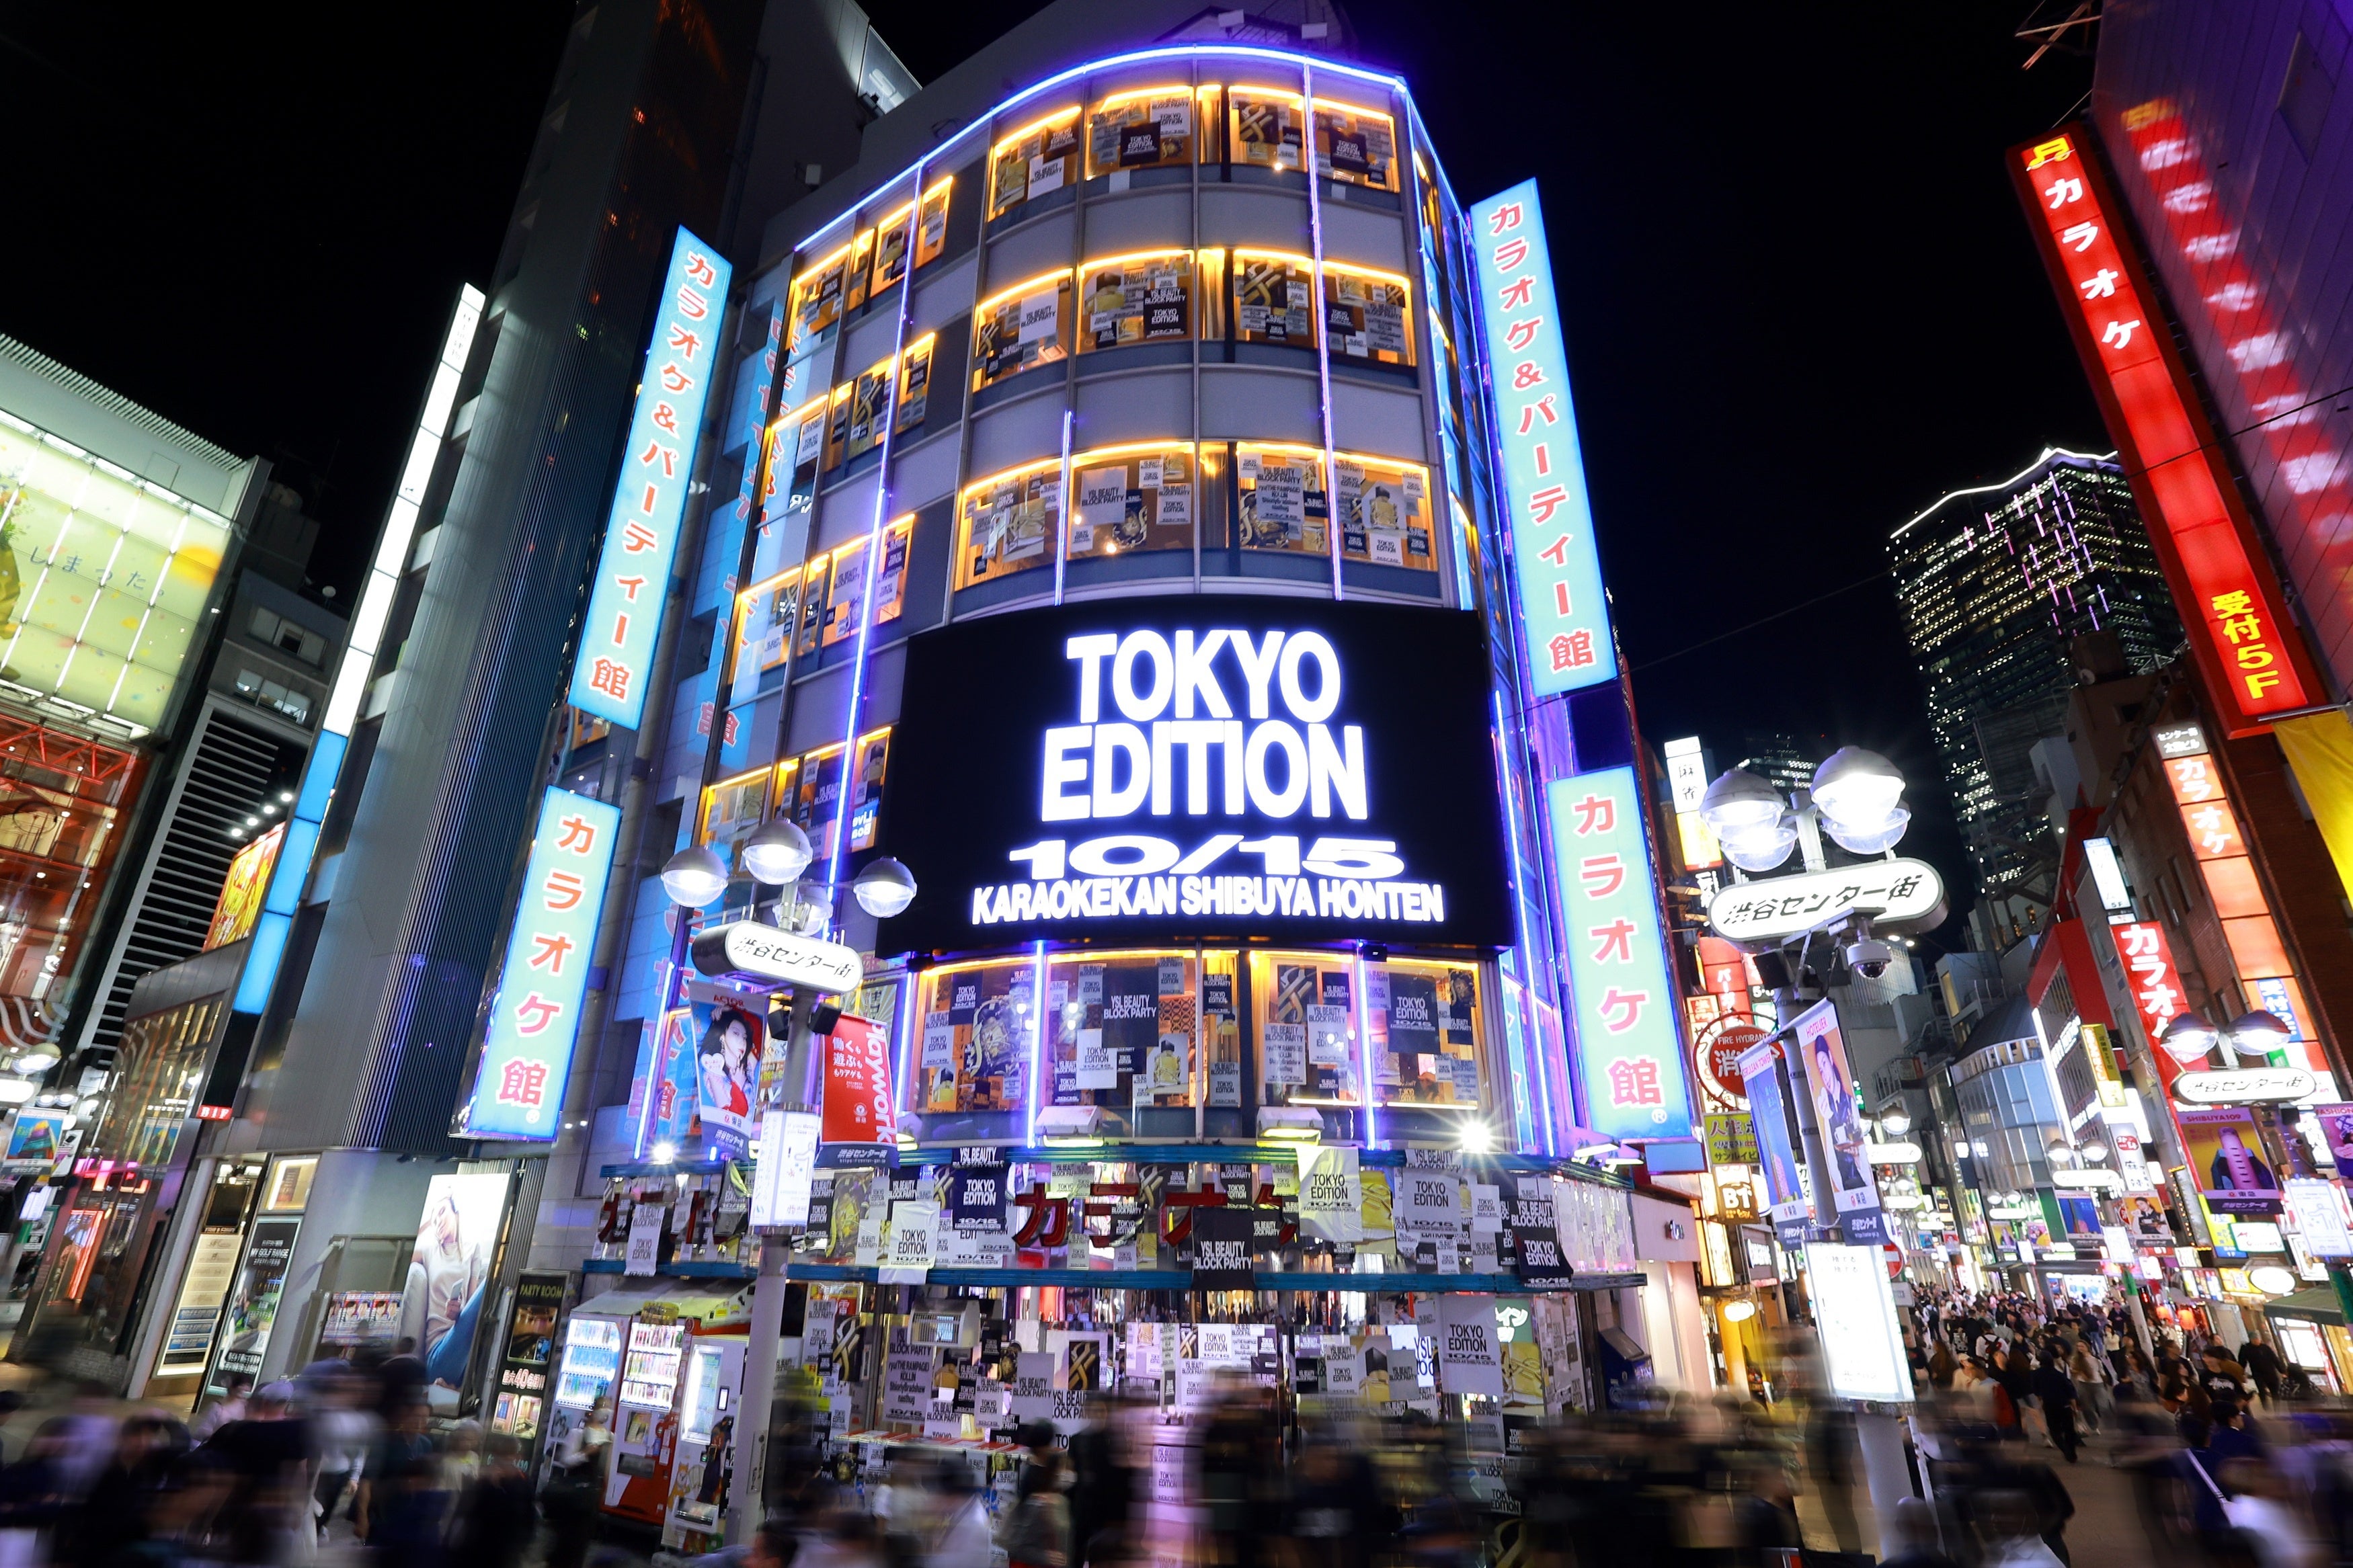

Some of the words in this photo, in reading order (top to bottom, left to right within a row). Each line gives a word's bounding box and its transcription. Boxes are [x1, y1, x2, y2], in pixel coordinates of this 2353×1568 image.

[1130, 135, 1151, 144] TOKYO
[2044, 177, 2141, 349] カラオケ
[1154, 308, 1177, 317] TOKYO
[1152, 315, 1179, 324] EDITION
[1488, 202, 1598, 673] カラオケ&パーティー館
[590, 252, 715, 703] カラオケ&パーティー館
[1275, 468, 1295, 477] BEAUTY
[1257, 474, 1279, 482] BLOCK
[1279, 476, 1301, 485] PARTY
[1088, 489, 1099, 498] YSL
[1099, 487, 1119, 497] BEAUTY
[1082, 497, 1103, 507] BLOCK
[1103, 493, 1124, 504] PARTY
[2211, 589, 2280, 700] 受付5F
[1066, 630, 1341, 723] TOKYO
[1042, 720, 1367, 821] EDITION
[2174, 759, 2231, 854] カラオケ
[1009, 834, 1404, 880] 10/15
[971, 876, 1178, 925] KARAOKEKAN
[1180, 876, 1313, 918] SHIBUYA
[1325, 878, 1445, 922] HONTEN
[1723, 874, 1923, 926] 渋谷センター街
[733, 936, 853, 978] 渋谷センター街
[1571, 793, 1665, 1109] カラオケ館
[496, 814, 598, 1108] カラオケ館
[958, 985, 975, 994] TOKYO
[713, 994, 745, 1007] ACTOR
[956, 993, 976, 1001] EDITION
[1111, 995, 1123, 1008] YSL
[1123, 995, 1150, 1008] BEAUTY
[1398, 997, 1425, 1008] TOKYO
[1104, 1009, 1130, 1020] BLOCK
[1131, 1007, 1156, 1018] PARTY
[1396, 1009, 1428, 1020] EDITION
[1806, 1016, 1828, 1038] HOTELIER
[1285, 1034, 1303, 1042] PARTY
[1718, 1036, 1734, 1045] FIRE
[1736, 1033, 1768, 1042] HYDRANT
[832, 1036, 862, 1055] 働くも
[928, 1043, 947, 1051] EDITION
[833, 1053, 863, 1069] 遊ぶも
[2187, 1076, 2304, 1094] 渋谷センター街
[2186, 1114, 2242, 1122] SHIBUYA109
[837, 1149, 887, 1159] 渋谷センター街
[960, 1147, 971, 1161] YSL
[971, 1147, 997, 1161] BEAUTY
[1414, 1151, 1427, 1163] YSL
[1428, 1151, 1453, 1163] BEAUTY
[967, 1180, 995, 1192] TOKYO
[1313, 1174, 1345, 1186] TOKYO
[1311, 1187, 1348, 1199] EDITION
[1416, 1181, 1445, 1194] TOKYO
[963, 1192, 996, 1206] EDITION
[1414, 1194, 1449, 1207] EDITION
[812, 1205, 826, 1214] TOKYO
[1517, 1200, 1529, 1216] YSL
[1530, 1201, 1554, 1216] BEAUTY
[809, 1213, 827, 1224] EDITION
[902, 1229, 926, 1241] TOKYO
[637, 1239, 652, 1248] TOKYO
[898, 1243, 927, 1255] EDITION
[1201, 1241, 1214, 1255] YSL
[1215, 1241, 1244, 1256] BEAUTY
[1524, 1240, 1554, 1253] TOKYO
[258, 1249, 271, 1257] GOLF
[271, 1249, 289, 1258] RANGE
[633, 1251, 651, 1260] EDITION
[1194, 1257, 1223, 1270] BLOCK
[1224, 1257, 1252, 1270] PARTY
[1525, 1253, 1560, 1267] EDITION
[520, 1284, 540, 1296] PARTY
[541, 1285, 563, 1298] ROOM
[811, 1328, 826, 1336] TOKYO
[1449, 1324, 1484, 1338] TOKYO
[1205, 1333, 1226, 1343] TOKYO
[889, 1344, 910, 1354] BLOCK
[910, 1345, 930, 1356] PARTY
[1204, 1343, 1228, 1352] EDITION
[1448, 1338, 1487, 1352] EDITION
[1447, 1352, 1491, 1360] 10/15
[1019, 1378, 1027, 1387] YSL
[1027, 1378, 1047, 1388] BEAUTY
[1013, 1389, 1032, 1397] BLOCK
[1032, 1389, 1051, 1397] PARTY
[980, 1406, 997, 1414] EDITION
[927, 1412, 942, 1420] BLOCK
[943, 1413, 961, 1423] PARTY
